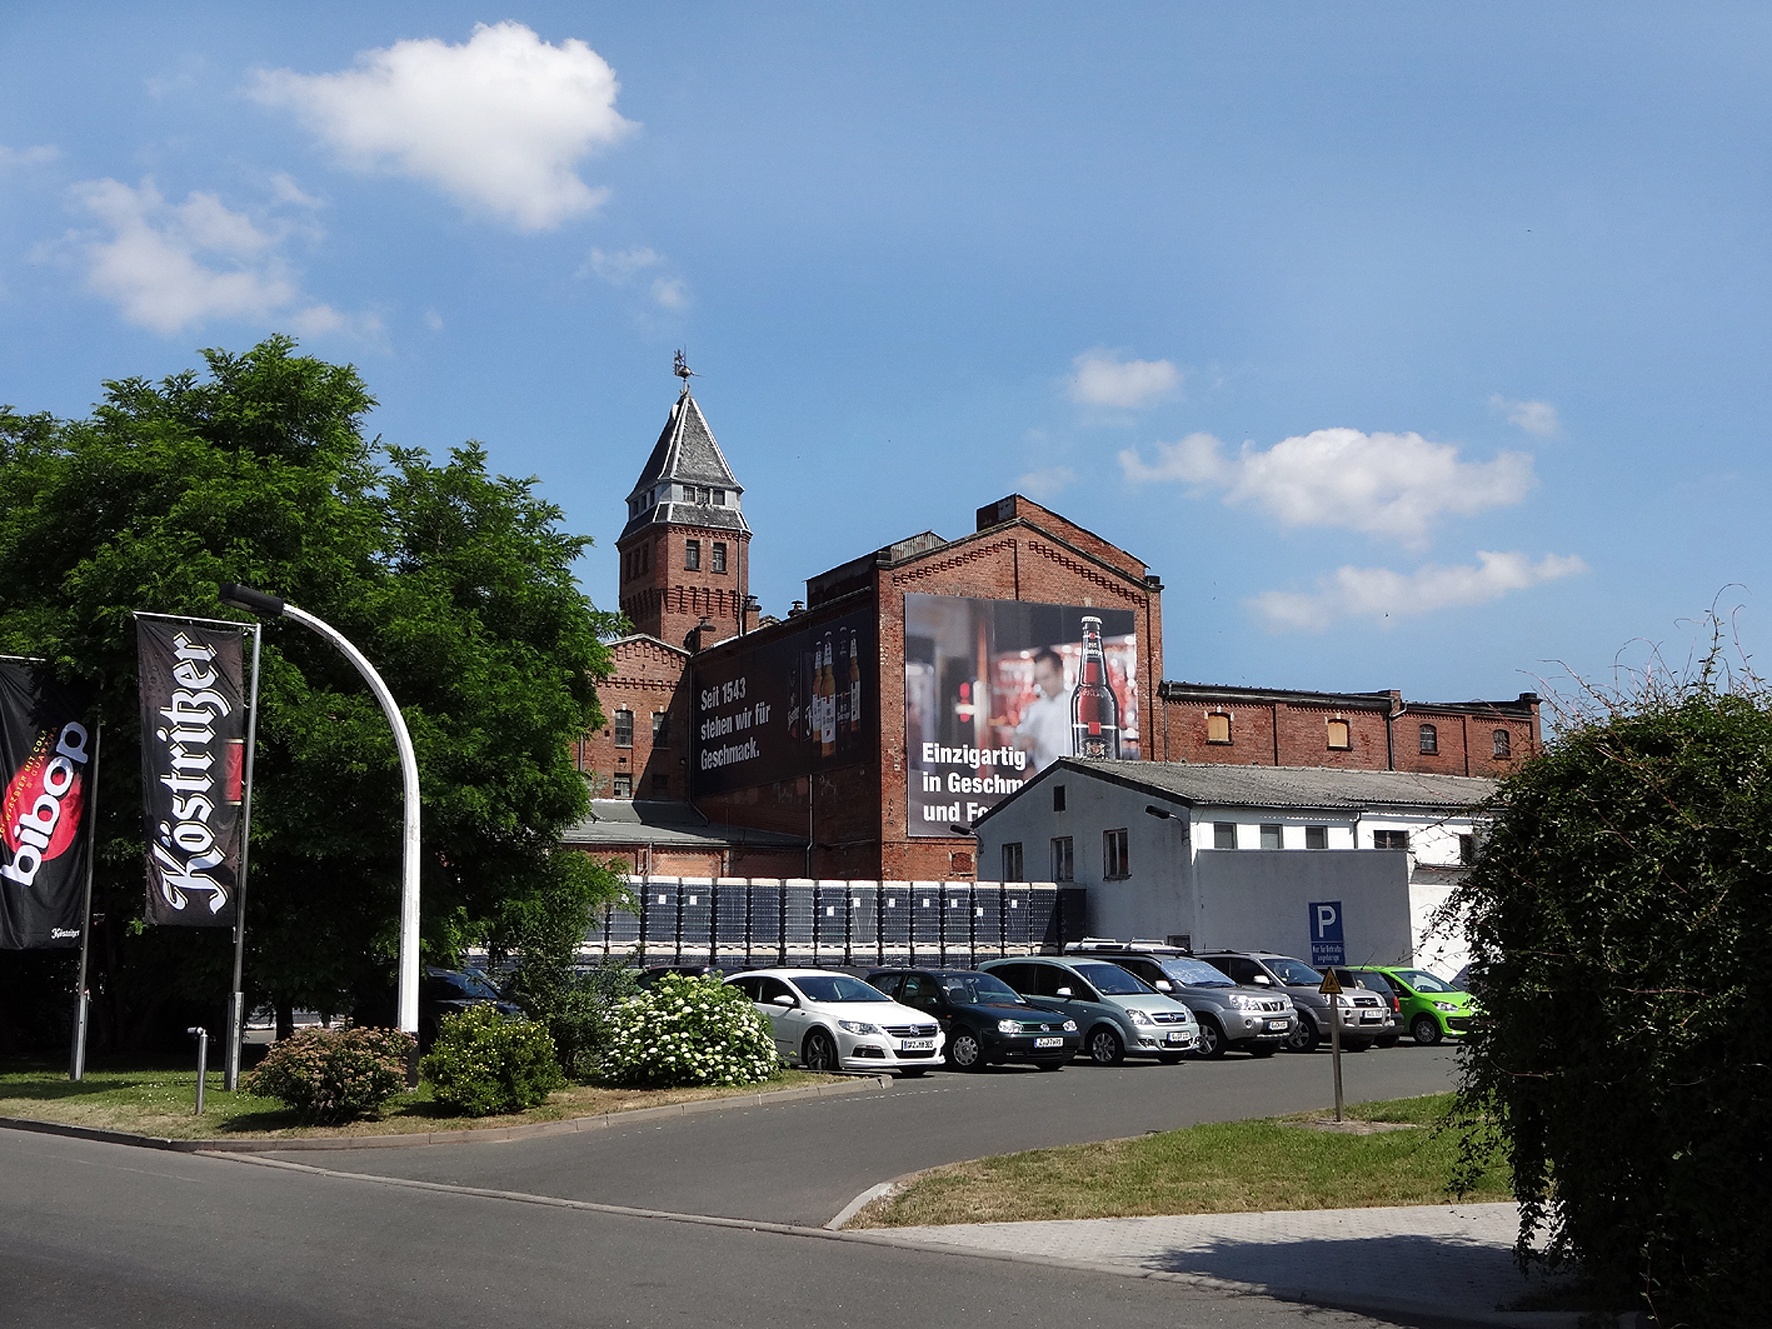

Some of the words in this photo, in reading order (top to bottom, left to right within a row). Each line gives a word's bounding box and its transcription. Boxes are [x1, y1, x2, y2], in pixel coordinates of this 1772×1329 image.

[701, 686, 720, 711] Seit
[722, 677, 746, 704] 1543
[701, 716, 733, 741] stehen
[735, 707, 753, 731] wir
[755, 701, 771, 726] für
[24, 755, 35, 773] MIT
[33, 730, 47, 753] COLA
[701, 736, 760, 771] Geschmack.
[922, 742, 1026, 771] Einzigartig
[153, 631, 232, 914] Köstritzer
[922, 771, 941, 793] in
[947, 772, 1029, 794] Geschm
[0, 721, 88, 887] bibop
[923, 801, 960, 822] und
[966, 801, 992, 822] Fo
[1317, 905, 1337, 938] P
